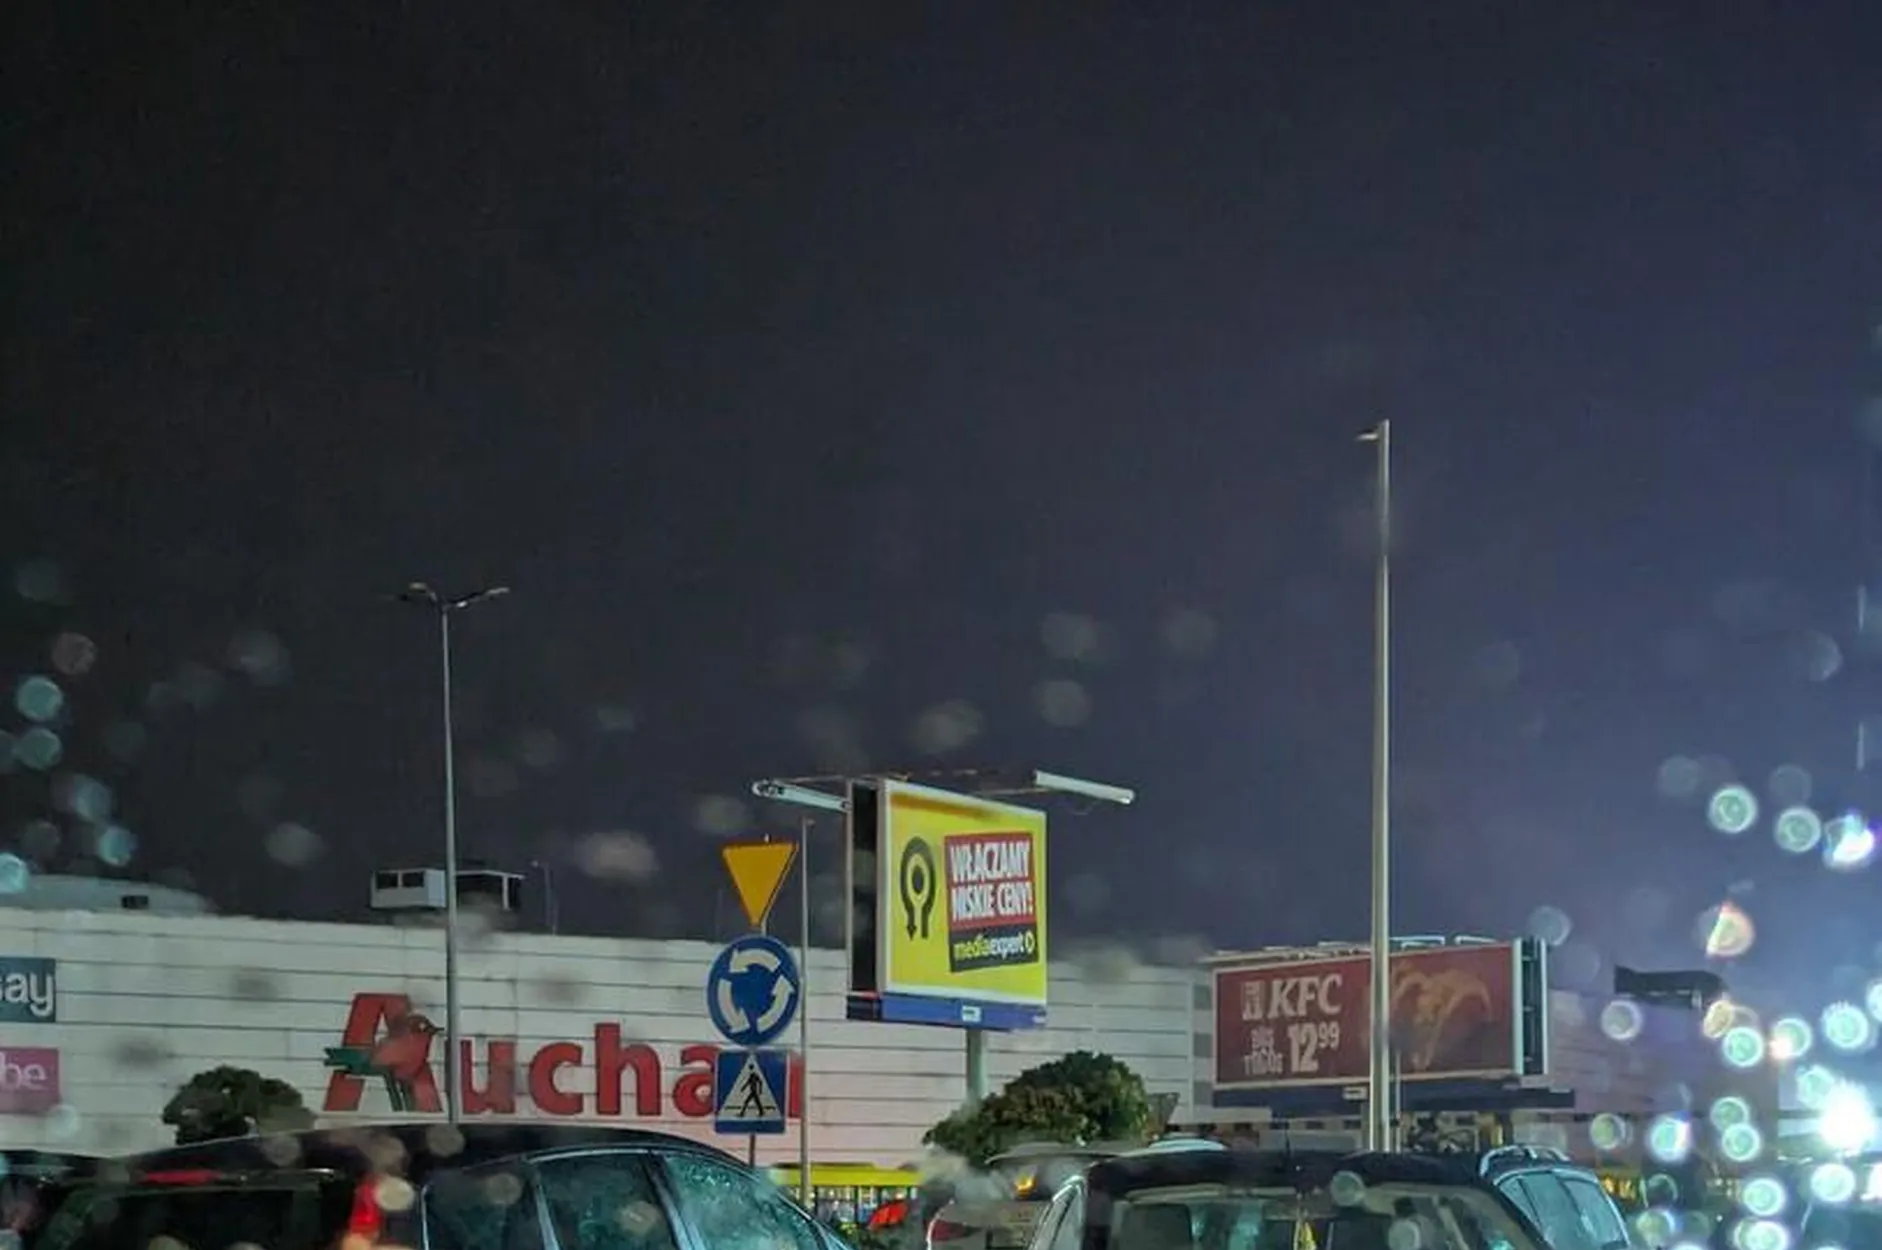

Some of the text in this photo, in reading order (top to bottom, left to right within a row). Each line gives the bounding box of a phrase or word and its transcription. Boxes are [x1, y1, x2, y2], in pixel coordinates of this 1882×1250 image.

[0, 971, 53, 1017] ay
[1267, 974, 1343, 1019] KFC
[323, 992, 805, 1119] Aucha
